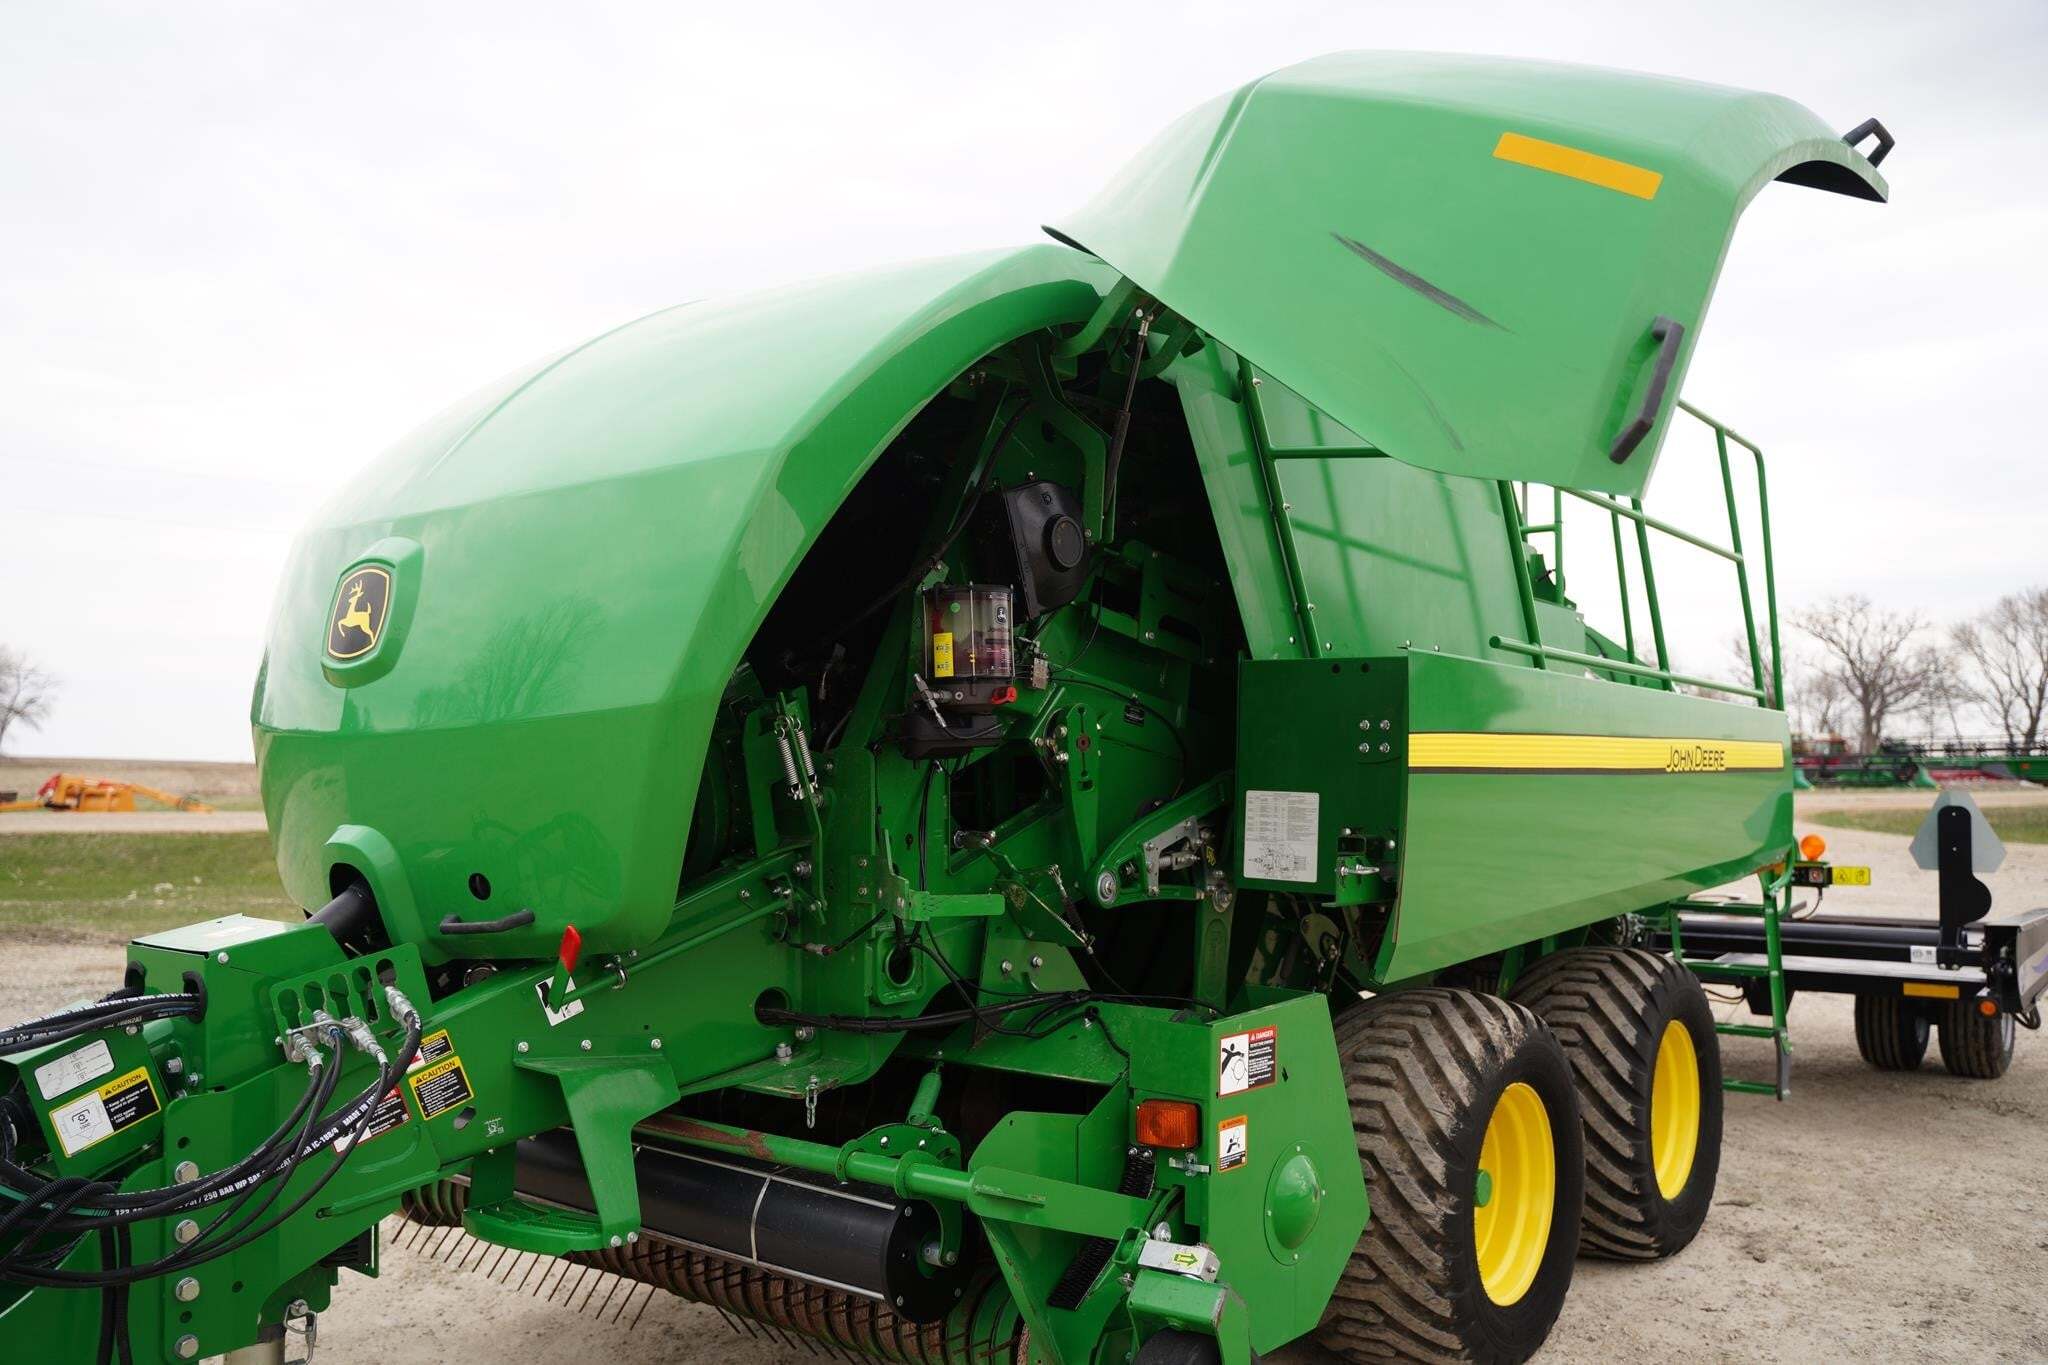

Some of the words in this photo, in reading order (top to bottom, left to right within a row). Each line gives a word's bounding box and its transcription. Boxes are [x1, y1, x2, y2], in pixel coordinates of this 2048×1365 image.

[1666, 745, 1693, 768] JOHN
[1695, 745, 1725, 767] DEERE
[423, 1061, 456, 1081] CAUTION
[111, 1073, 142, 1092] CAUTION
[203, 1190, 218, 1202] 250
[219, 1184, 235, 1196] BAR
[235, 1179, 248, 1193] WP
[342, 1110, 361, 1126] MADE
[359, 1101, 369, 1113] IN
